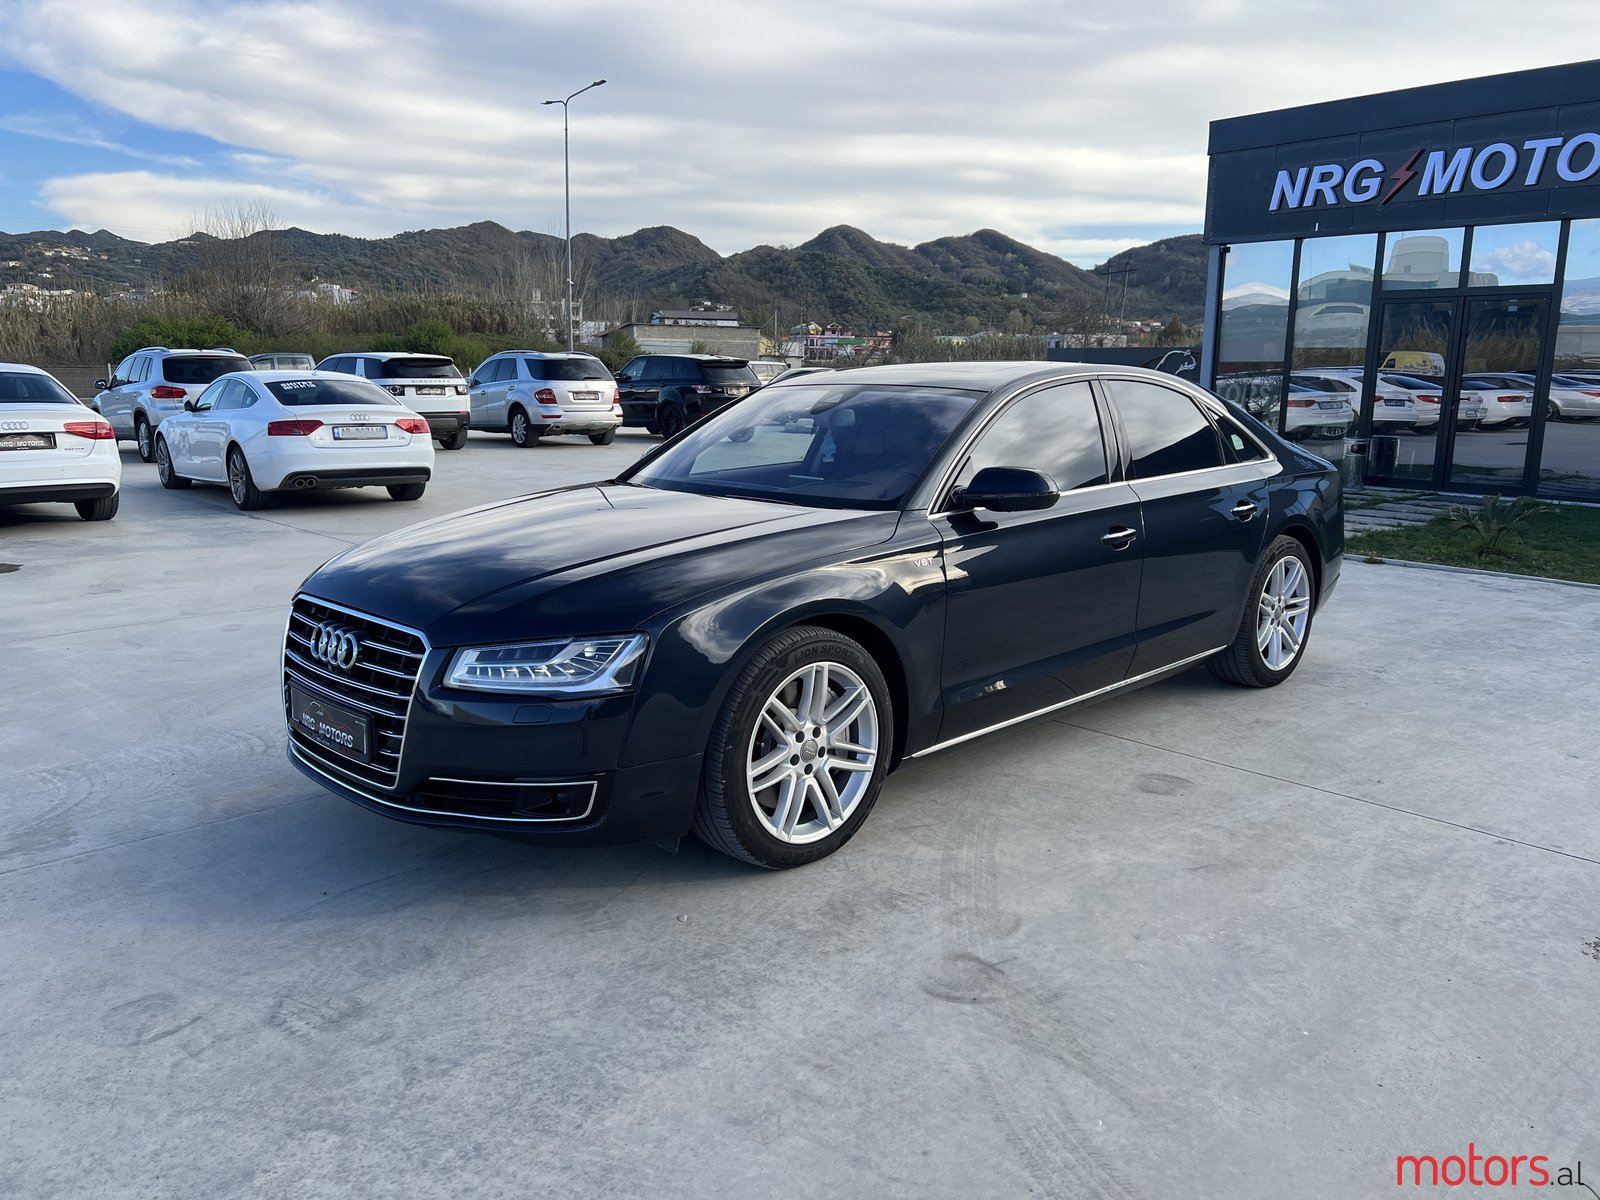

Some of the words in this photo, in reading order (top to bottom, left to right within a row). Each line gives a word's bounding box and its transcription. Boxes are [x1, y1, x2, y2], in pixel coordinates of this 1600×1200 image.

[1268, 158, 1386, 212] NRG
[913, 557, 934, 568] V8T
[302, 713, 316, 731] NRG
[319, 722, 354, 748] MOTORS
